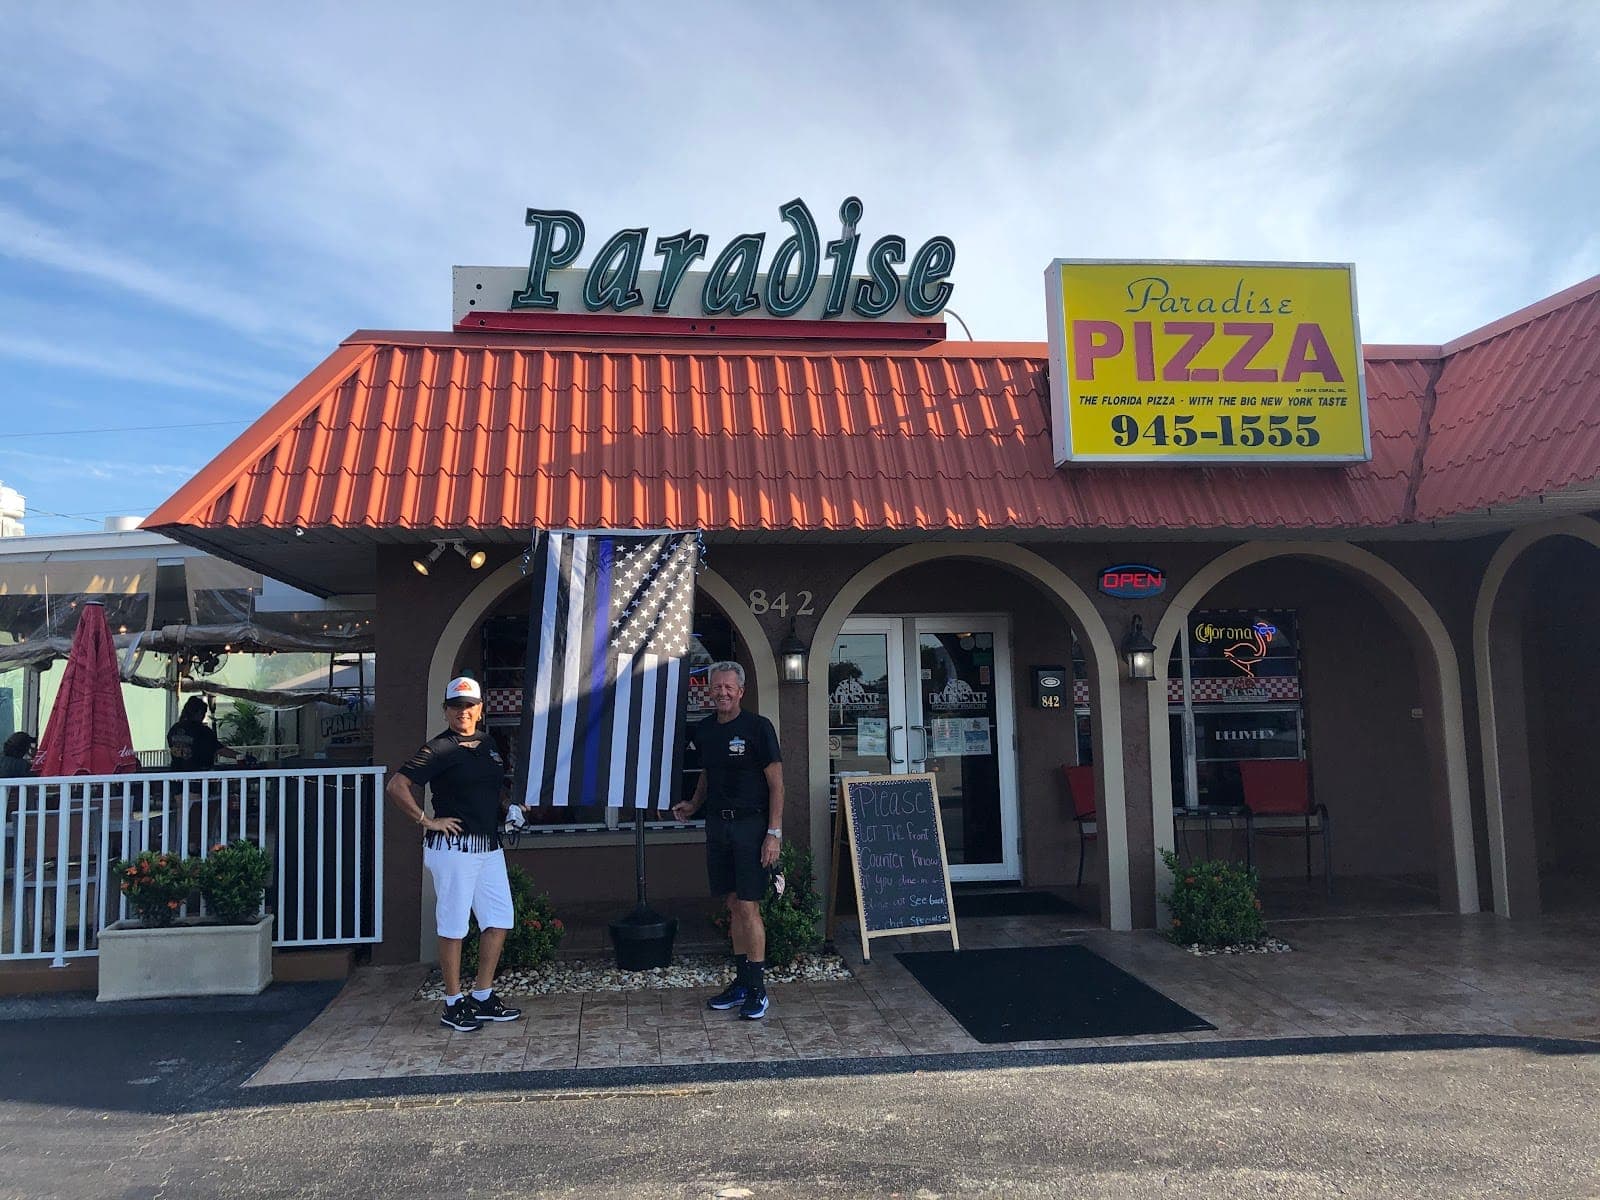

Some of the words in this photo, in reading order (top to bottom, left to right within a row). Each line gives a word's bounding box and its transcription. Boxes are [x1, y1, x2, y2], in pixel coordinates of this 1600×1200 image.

[510, 196, 956, 319] Paradise
[1124, 276, 1293, 314] Paradise
[1073, 320, 1344, 382] PIZZA
[1079, 396, 1098, 405] THE
[1101, 396, 1142, 405] FLORIDA
[1147, 396, 1175, 405] PIZZA
[1189, 396, 1213, 405] WITH
[1218, 396, 1237, 405] THE
[1240, 396, 1257, 406] BIG
[1260, 396, 1283, 406] NEW
[1288, 397, 1313, 406] YORK
[1318, 397, 1347, 406] TASTE
[1111, 413, 1321, 447] 945-1555
[1103, 573, 1162, 588] OPEN
[749, 588, 815, 618] 842
[1195, 623, 1253, 643] Corona
[1041, 695, 1060, 708] 842
[1215, 730, 1275, 741] DELIVERY
